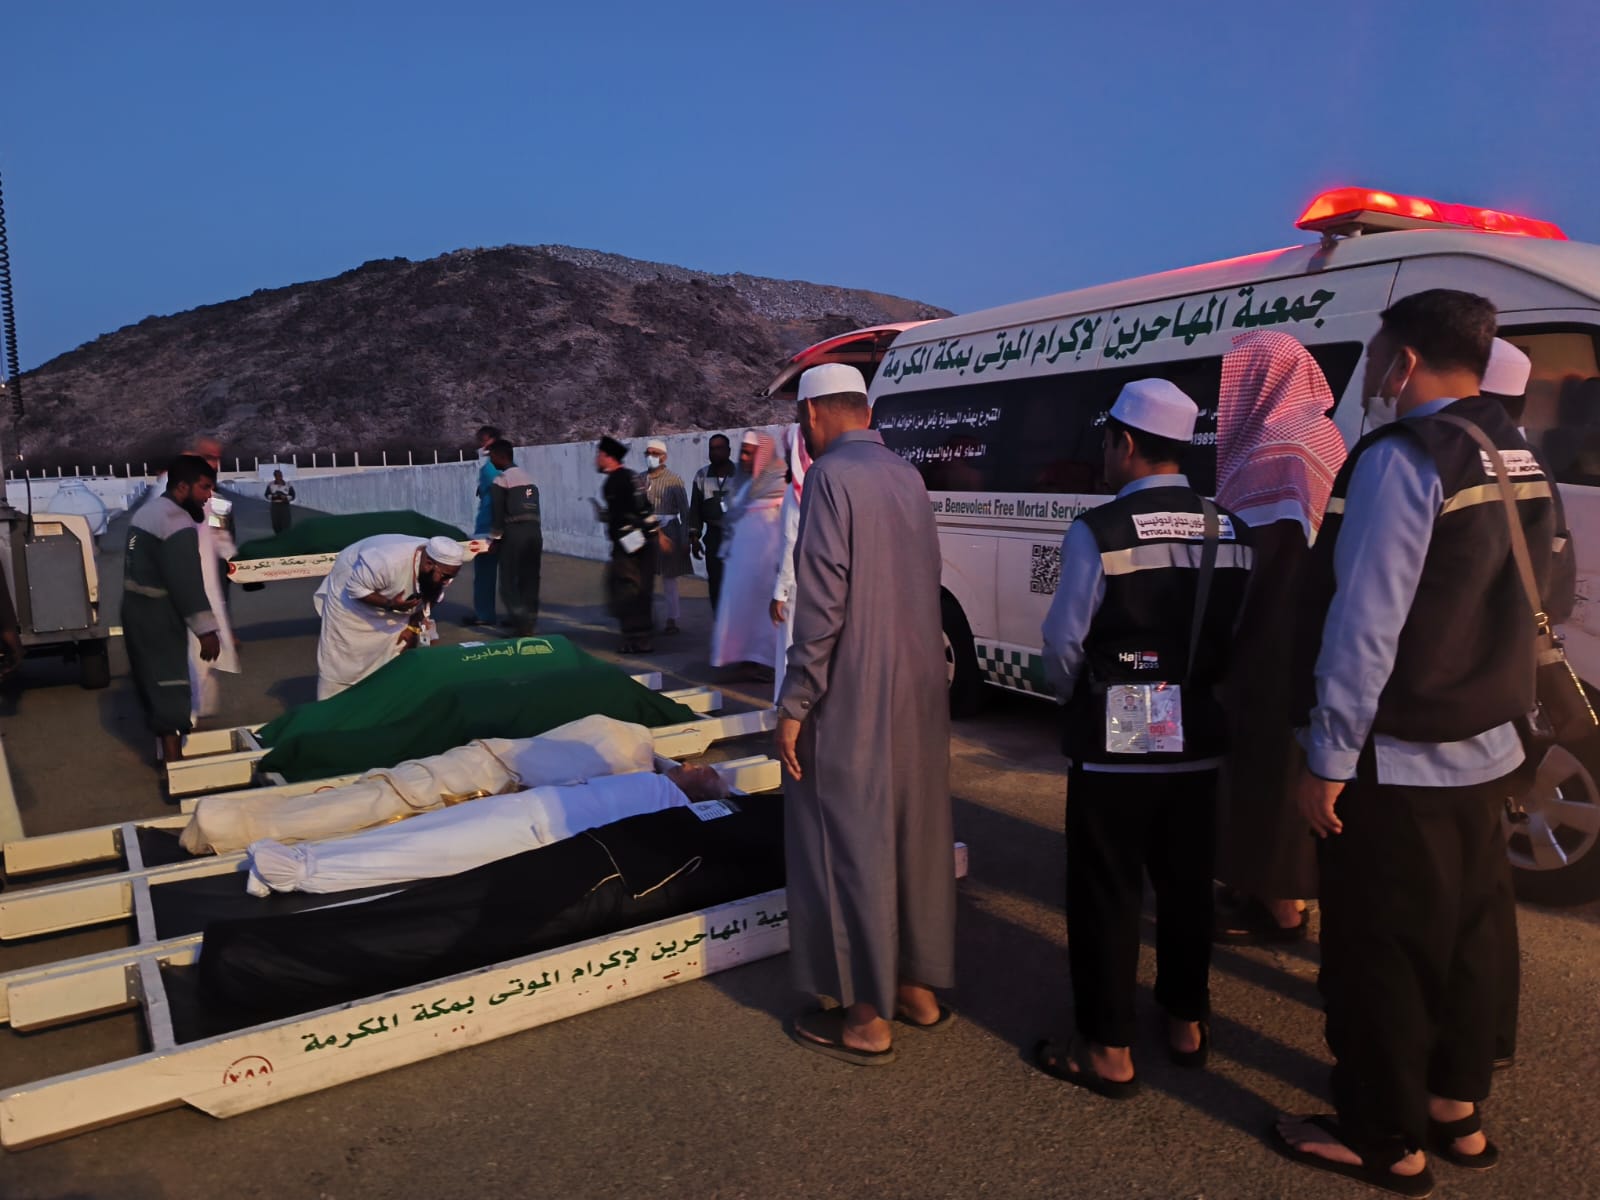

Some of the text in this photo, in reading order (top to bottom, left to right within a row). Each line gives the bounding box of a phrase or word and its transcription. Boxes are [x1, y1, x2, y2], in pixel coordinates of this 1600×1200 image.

[882, 346, 933, 384] المكرمة
[933, 338, 973, 376] بمكة
[945, 497, 992, 515] Benevolent
[994, 499, 1015, 517] Free
[1017, 501, 1048, 518] Mortal
[410, 995, 475, 1021] بمكة
[301, 1014, 399, 1052] المكرمة
